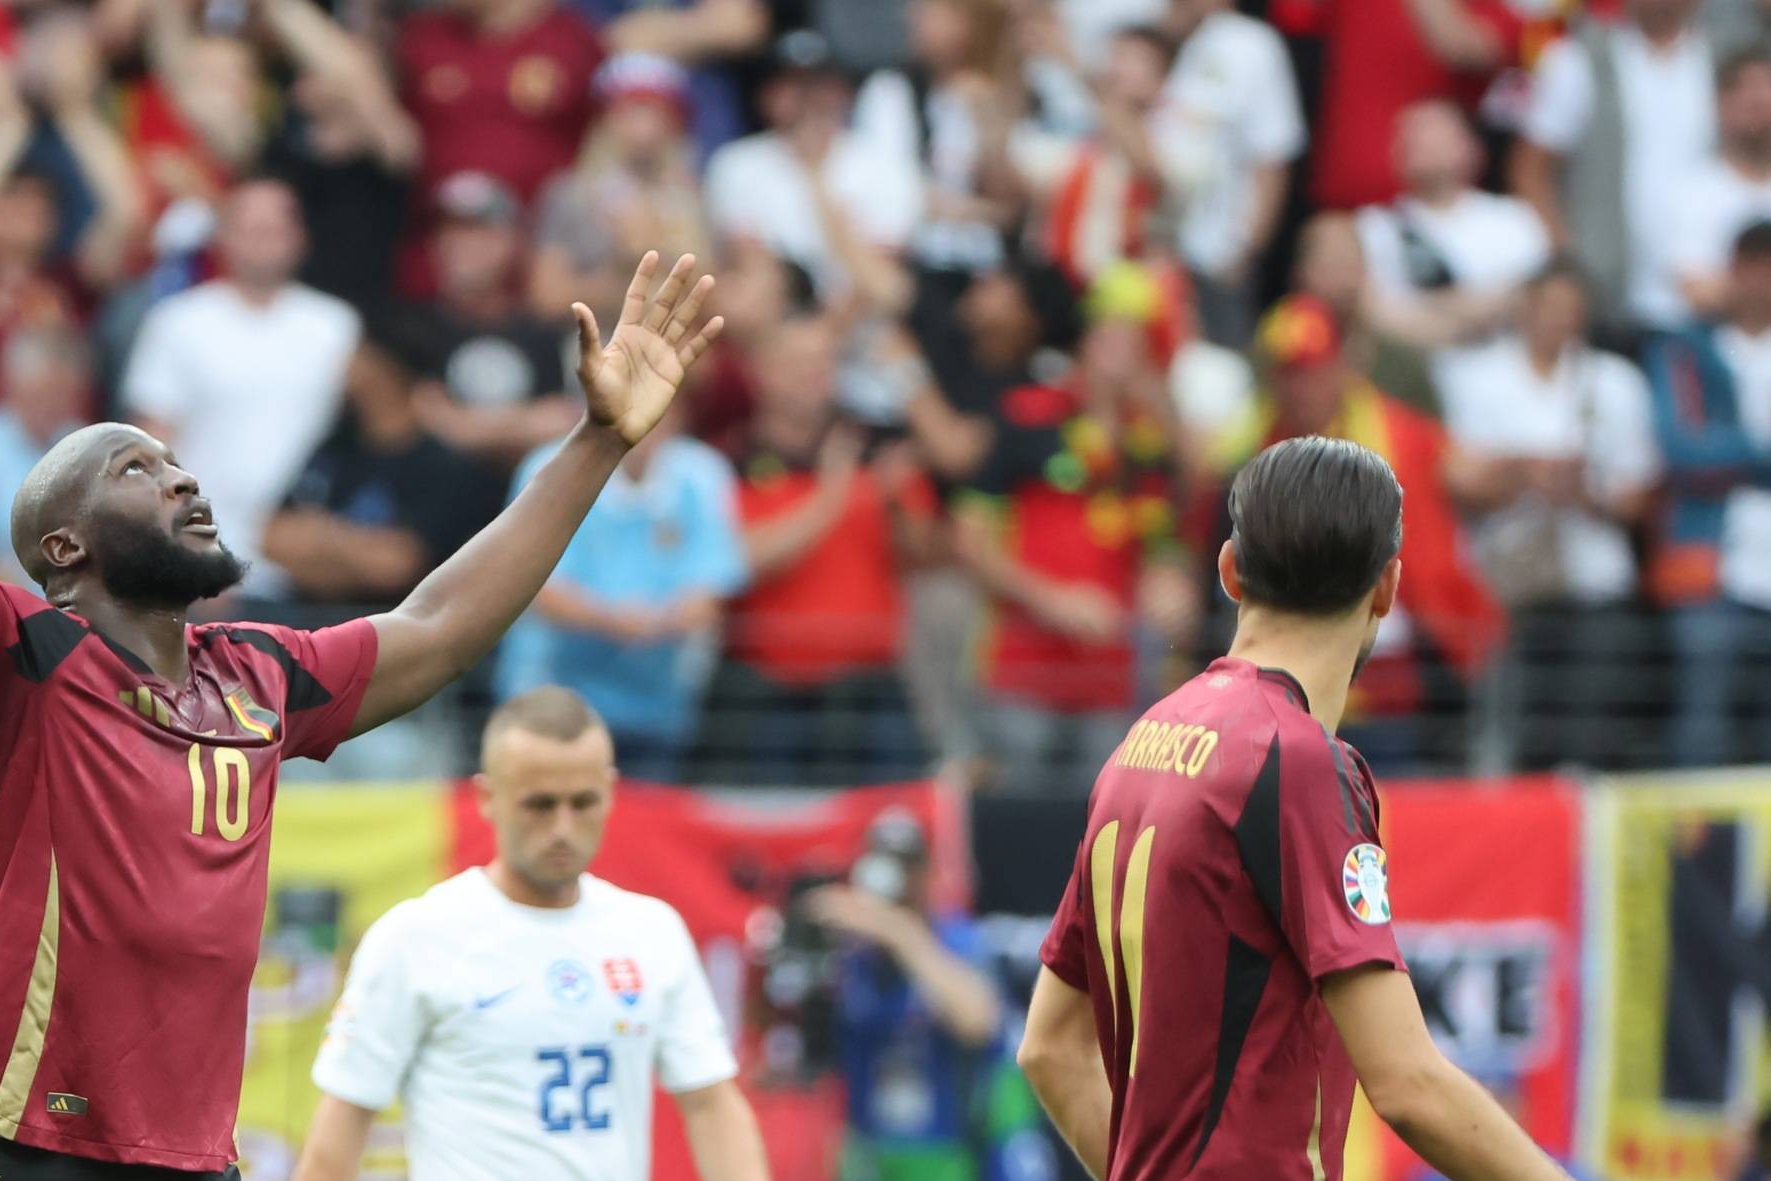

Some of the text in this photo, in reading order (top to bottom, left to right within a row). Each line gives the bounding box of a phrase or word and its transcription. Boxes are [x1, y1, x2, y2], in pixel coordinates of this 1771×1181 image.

[188, 743, 251, 841] 10
[1114, 719, 1220, 779] ARRASCO
[1091, 820, 1156, 1078] 11
[536, 1047, 611, 1130] 22
